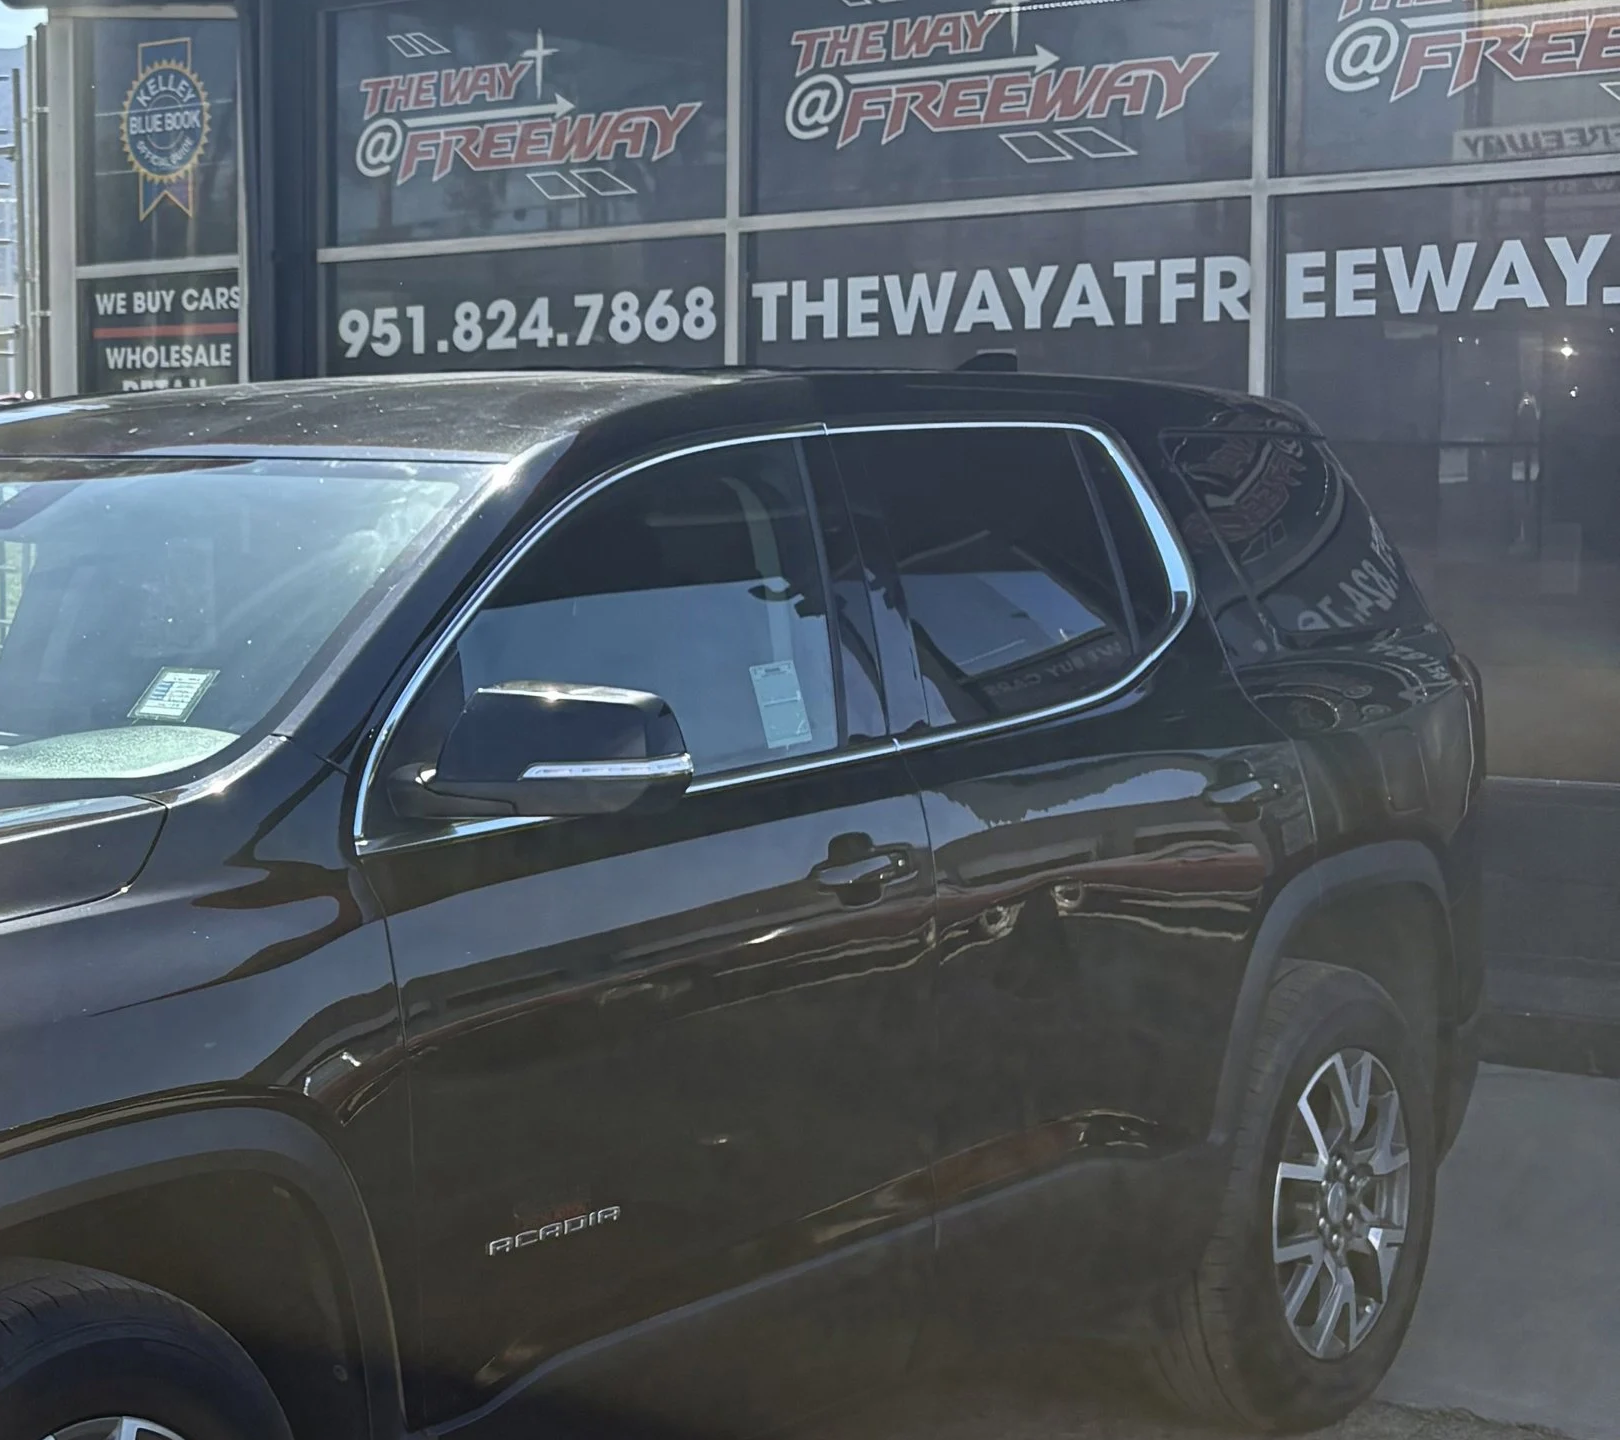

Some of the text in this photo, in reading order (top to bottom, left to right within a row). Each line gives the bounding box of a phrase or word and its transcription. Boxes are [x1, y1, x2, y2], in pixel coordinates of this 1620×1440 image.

[791, 9, 1009, 77] THE WAY
[136, 73, 196, 107] KELLEY
[359, 60, 535, 120] THE WAY
[129, 109, 201, 135] BLUE BOOK
[95, 286, 240, 316] WE BUY CARS
[338, 286, 717, 359] 951.824.7868
[105, 343, 232, 370] WHOLESALE
[487, 1205, 621, 1256] ACADIA
